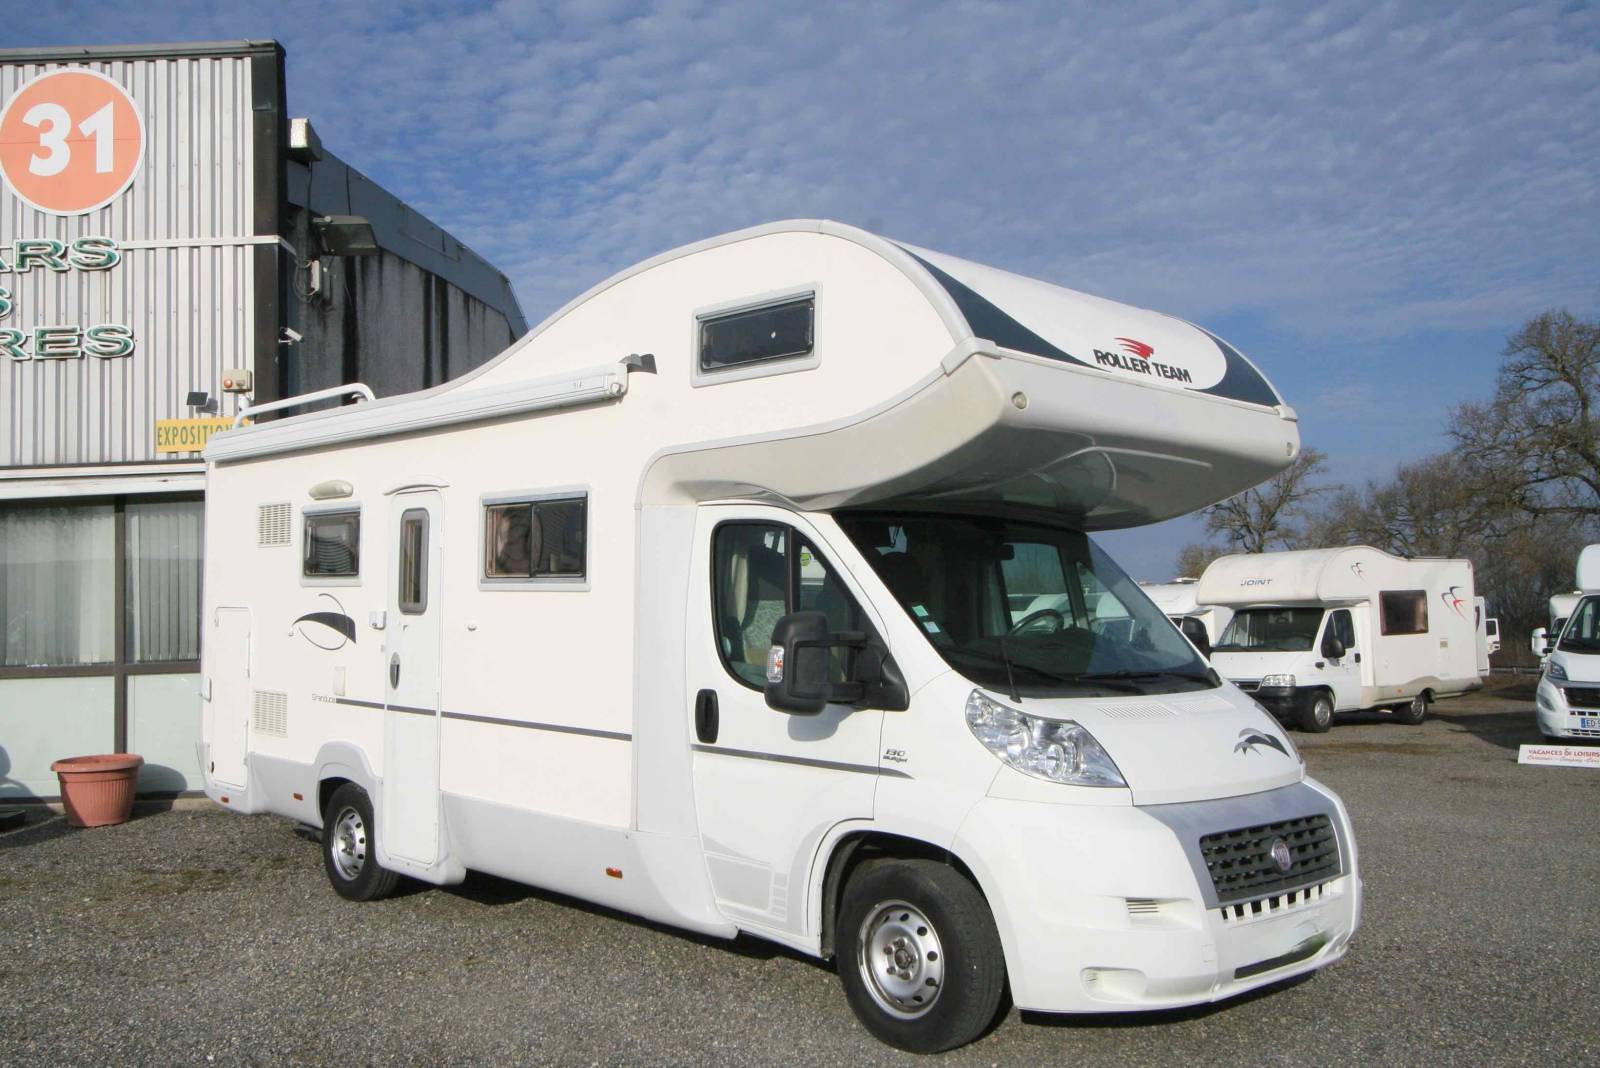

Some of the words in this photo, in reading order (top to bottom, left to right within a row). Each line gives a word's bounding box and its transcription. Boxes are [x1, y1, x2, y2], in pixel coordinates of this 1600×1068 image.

[22, 100, 114, 176] 31
[1093, 348, 1152, 376] ROLLER
[1152, 361, 1192, 384] TEAM
[1240, 578, 1272, 587] JOINT
